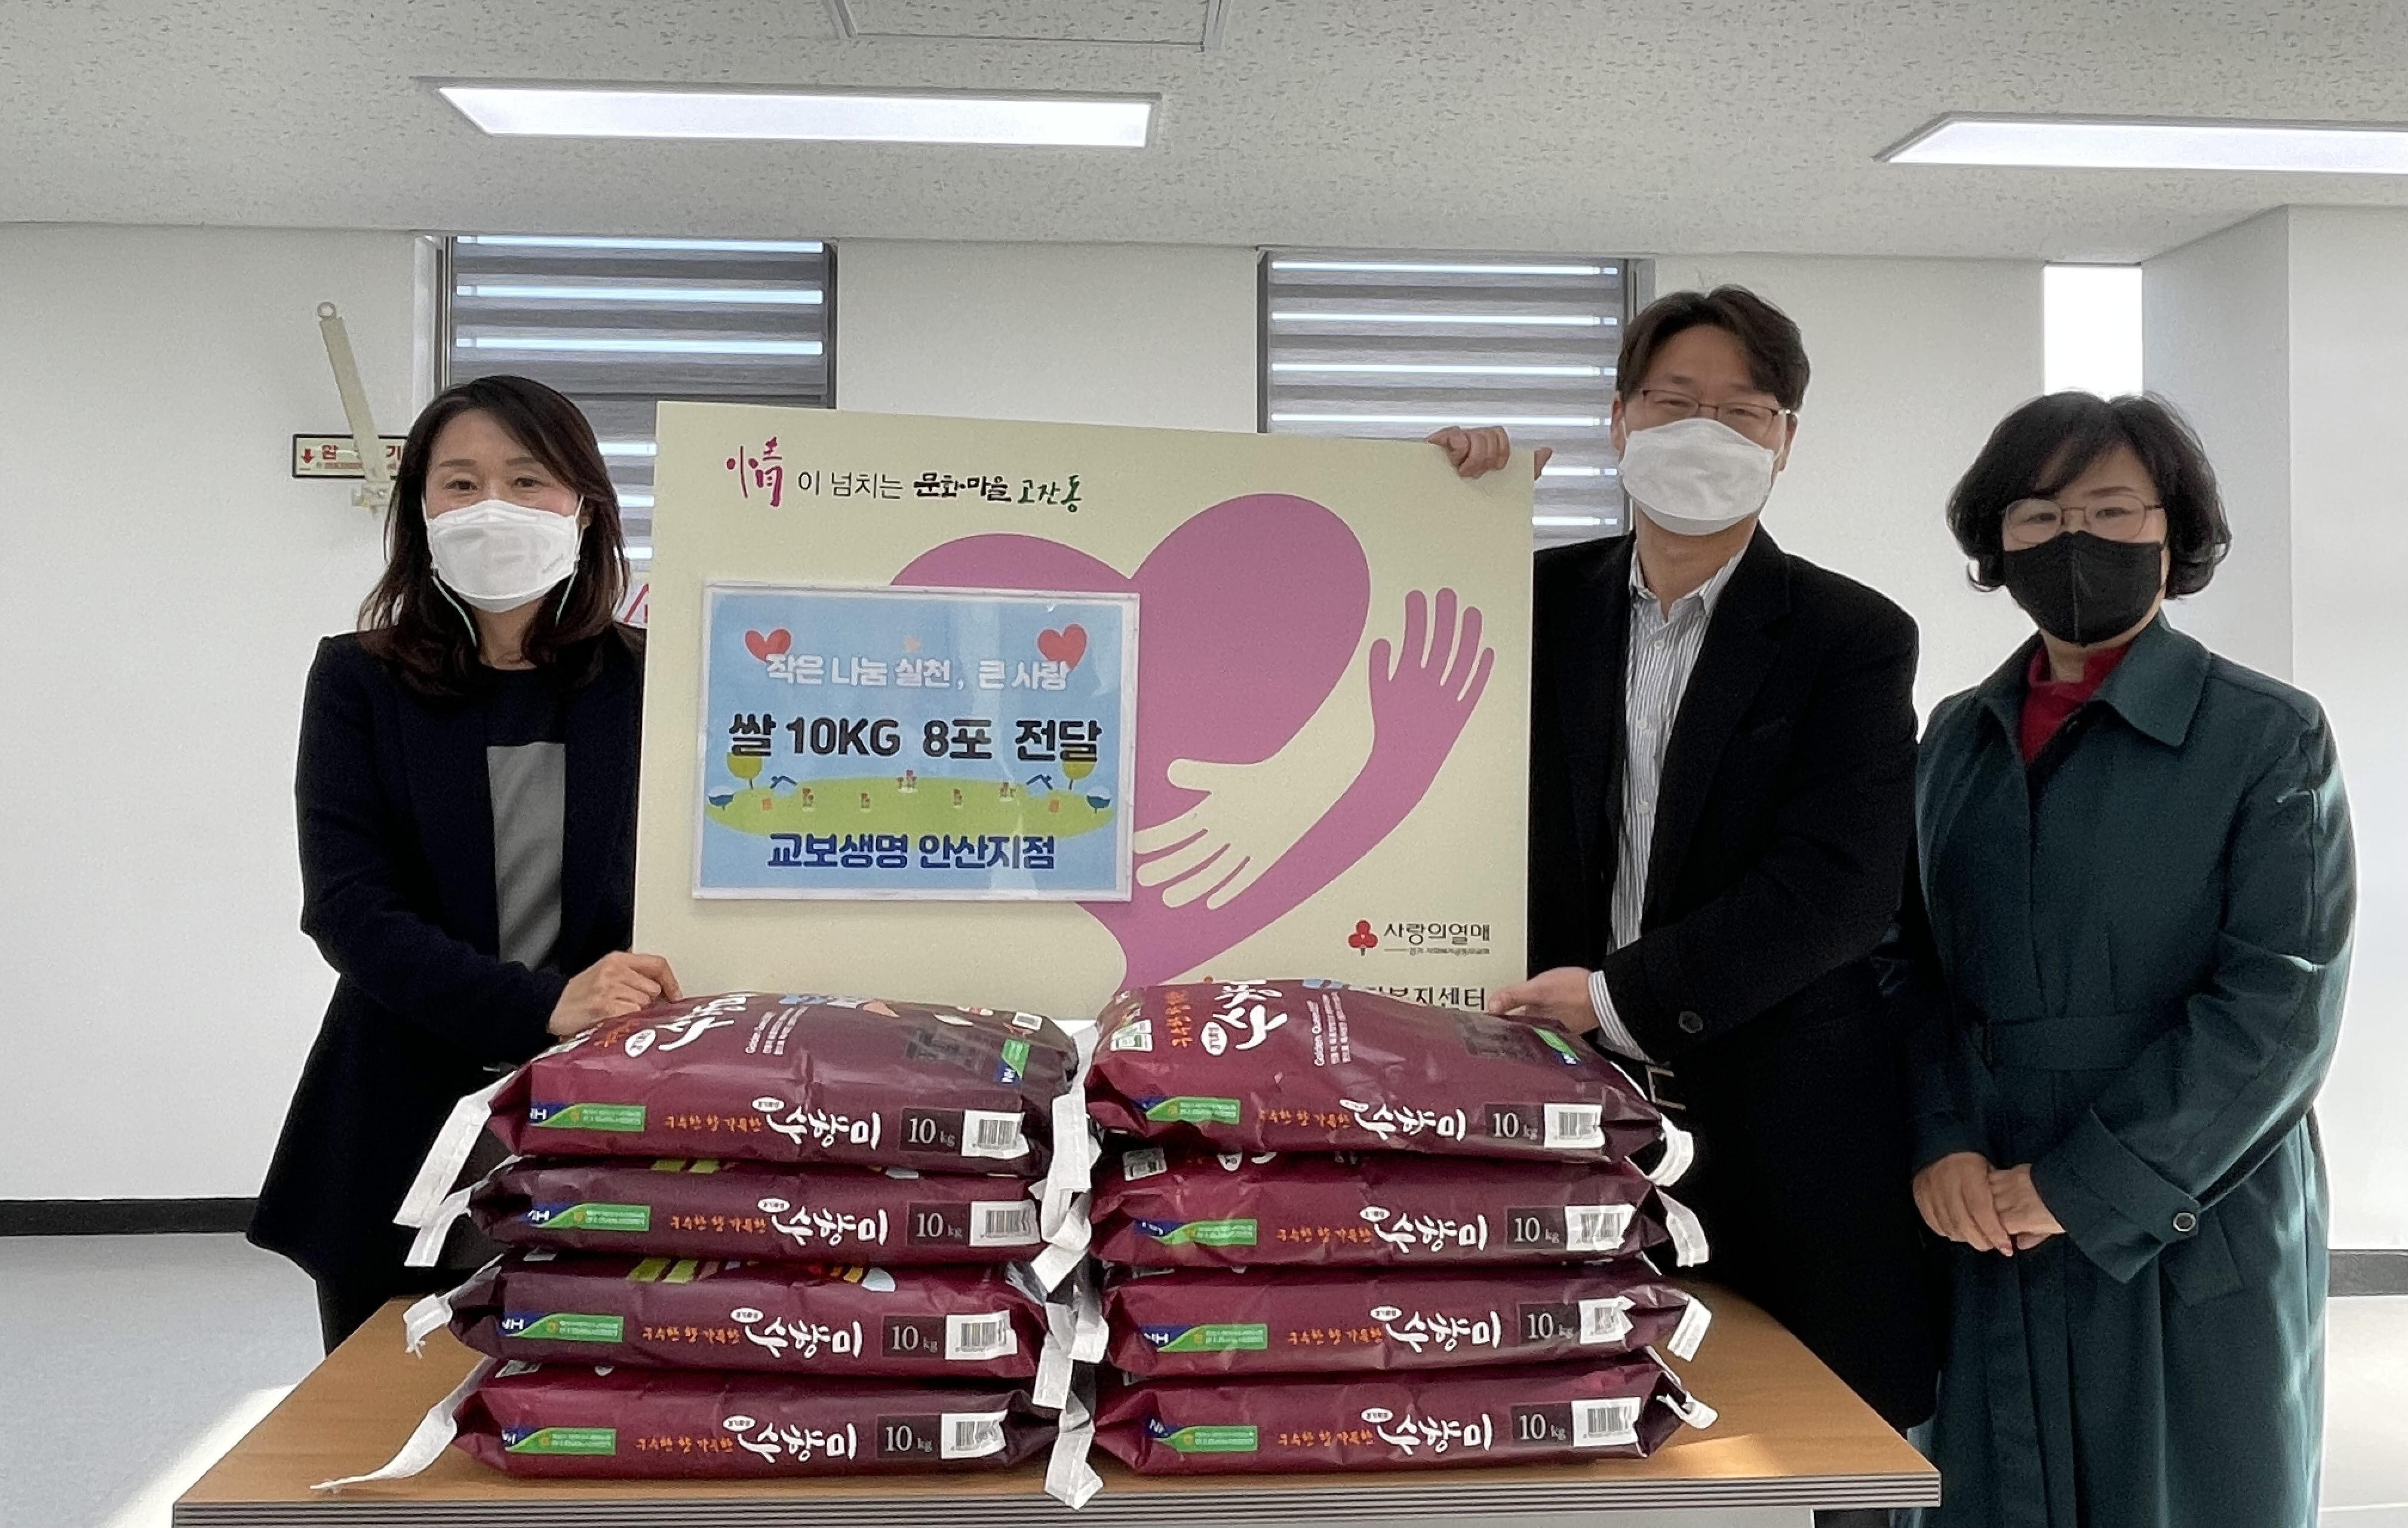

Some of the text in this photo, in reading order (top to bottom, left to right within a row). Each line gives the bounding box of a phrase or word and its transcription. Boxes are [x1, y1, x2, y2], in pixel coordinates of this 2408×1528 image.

[831, 472, 903, 499] 넘치는
[1018, 474, 1082, 513] 고잔동
[766, 655, 824, 687] 작은
[831, 656, 887, 687] 나눔
[978, 660, 1005, 689] 큰
[1012, 661, 1070, 691] 사랑
[729, 713, 1102, 762] 쌀 10KG 8포 전달
[767, 833, 1055, 870] 교보생명 안산지점
[1383, 922, 1491, 945] 사랑의열매
[766, 1106, 881, 1150] 수향미
[1354, 1104, 1466, 1142] 수향미
[772, 1206, 889, 1246] 수향미
[1375, 1213, 1487, 1253] 수향미
[745, 1317, 862, 1358] 수향미
[1386, 1311, 1501, 1353] 수향미
[738, 1422, 858, 1463] 수향미
[1377, 1413, 1492, 1455] 수향미
